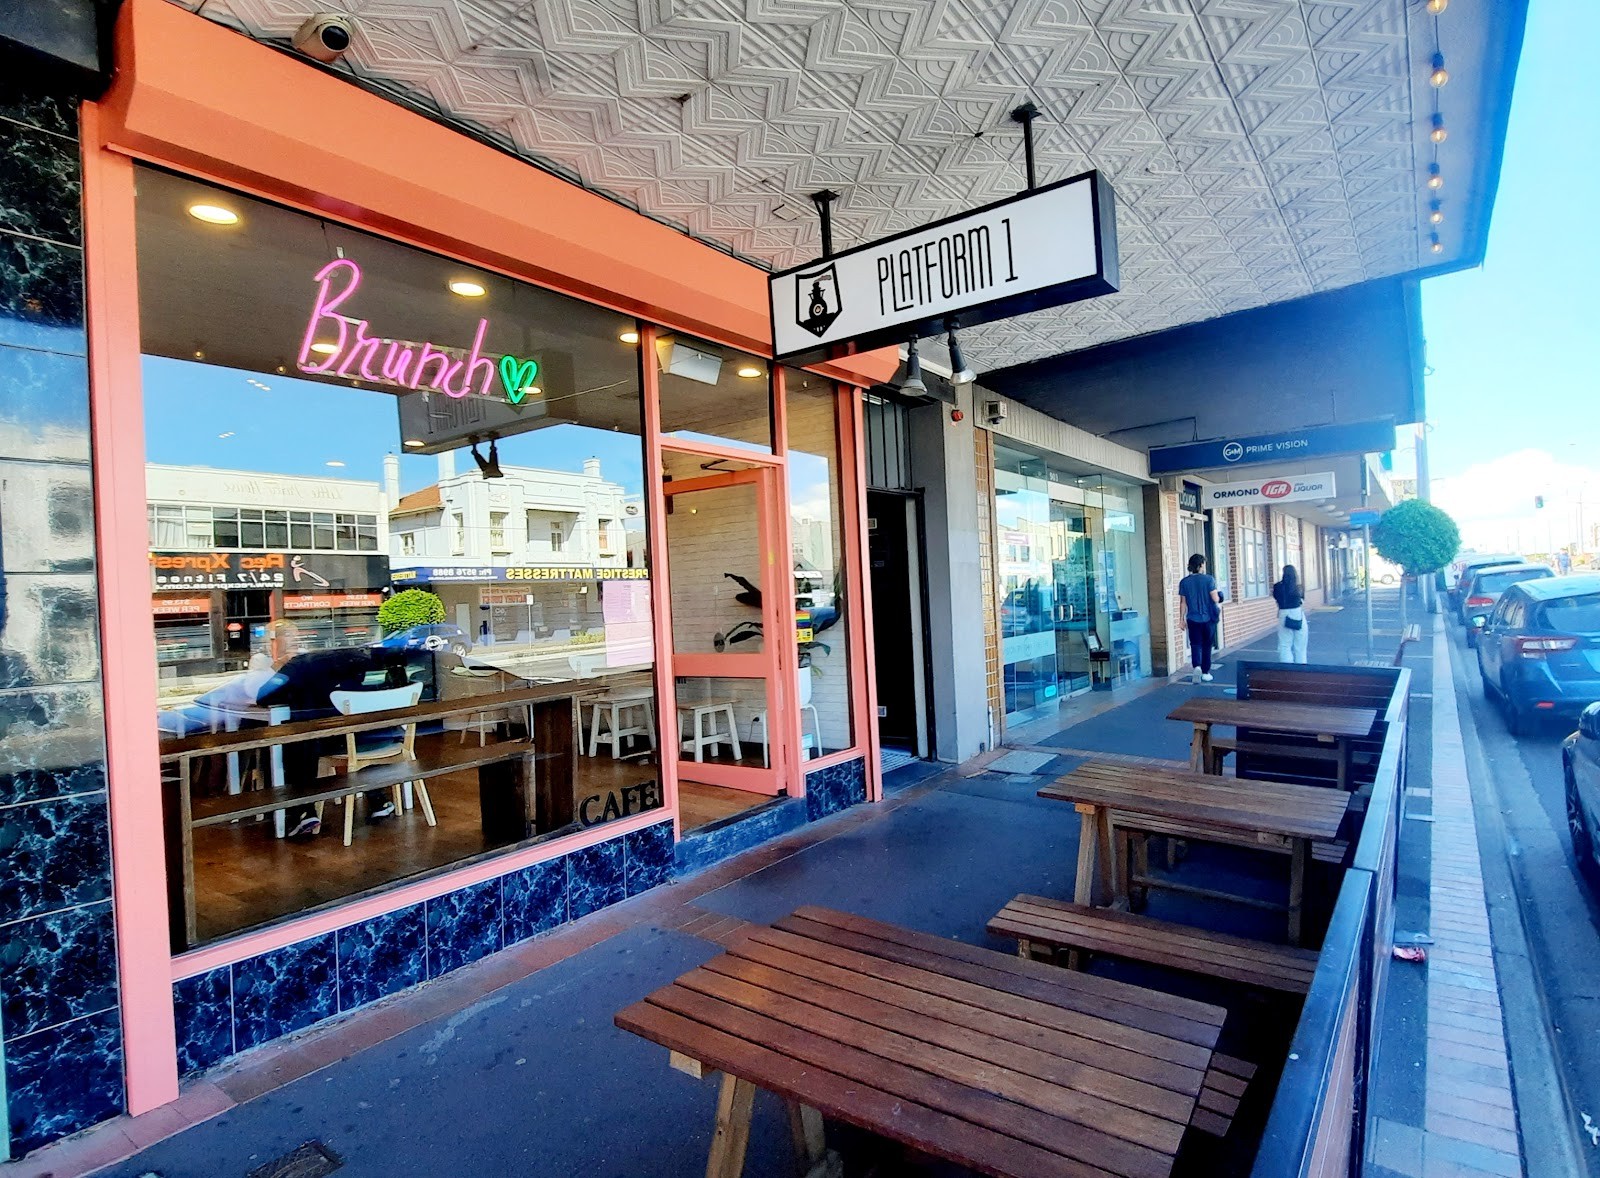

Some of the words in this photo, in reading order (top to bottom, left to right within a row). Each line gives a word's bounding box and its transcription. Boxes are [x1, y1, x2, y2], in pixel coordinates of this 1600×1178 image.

[877, 224, 993, 316] PLATFORM
[1001, 218, 1018, 282] 1
[297, 258, 496, 398] Brunch
[1246, 443, 1273, 454] PRIME
[1276, 440, 1309, 450] VISION
[1213, 488, 1259, 499] ORMOND
[1265, 483, 1288, 495] IGA
[580, 780, 660, 827] CAFE
